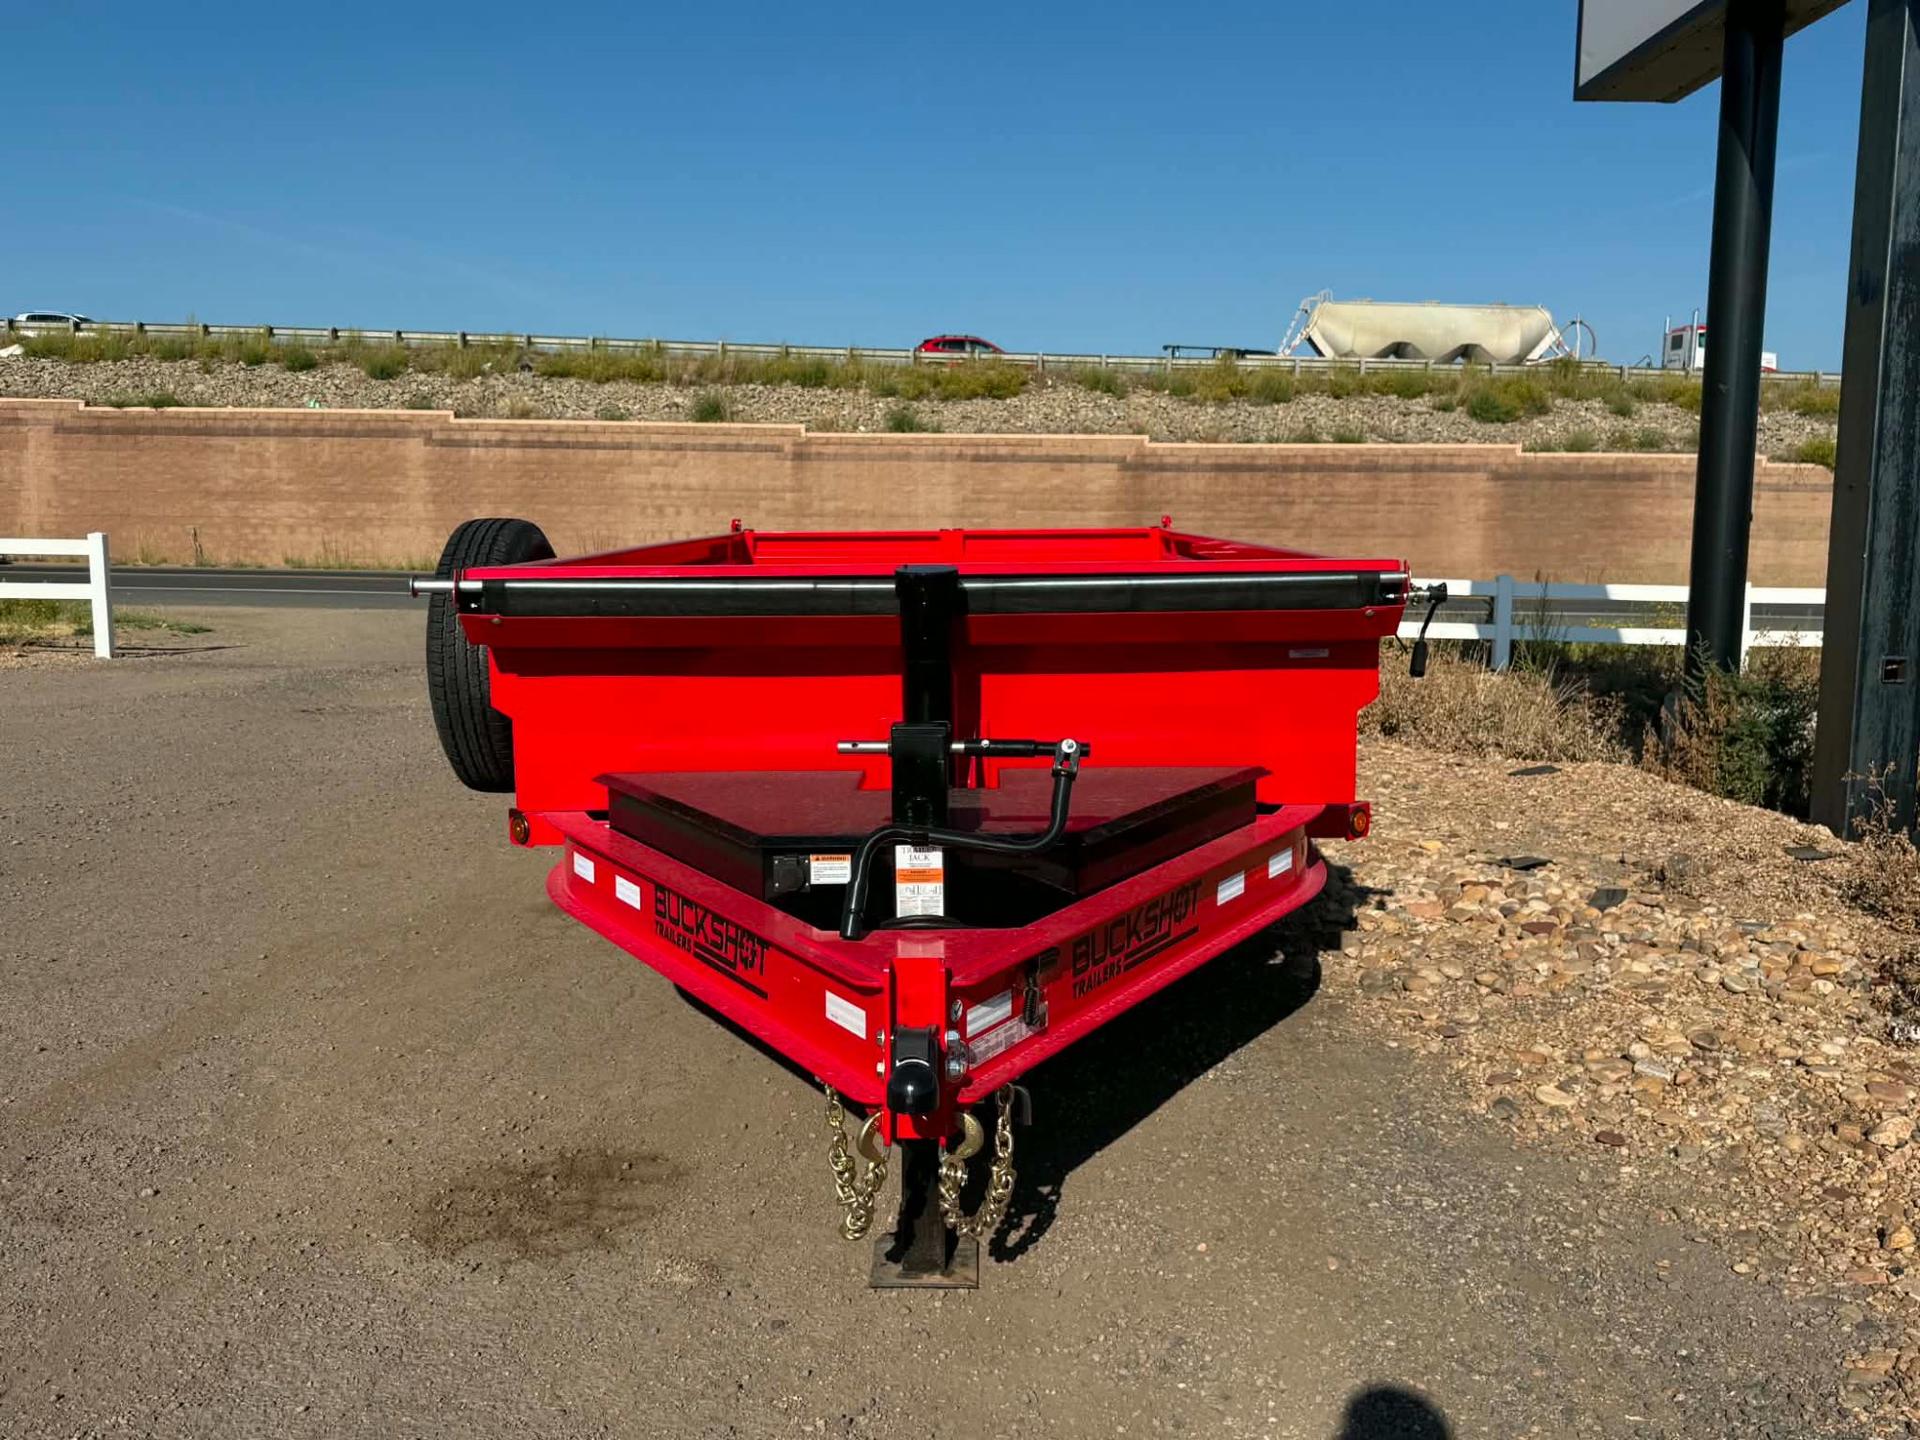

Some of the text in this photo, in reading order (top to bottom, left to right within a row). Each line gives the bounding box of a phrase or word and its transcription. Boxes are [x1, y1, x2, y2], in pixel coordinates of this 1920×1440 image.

[909, 854, 930, 862] JACK
[655, 884, 771, 976] BUCKSHOT
[656, 920, 693, 953] TRAILERS
[1072, 880, 1202, 977] BUCKSHOT
[1073, 958, 1122, 999] TRAILERS
